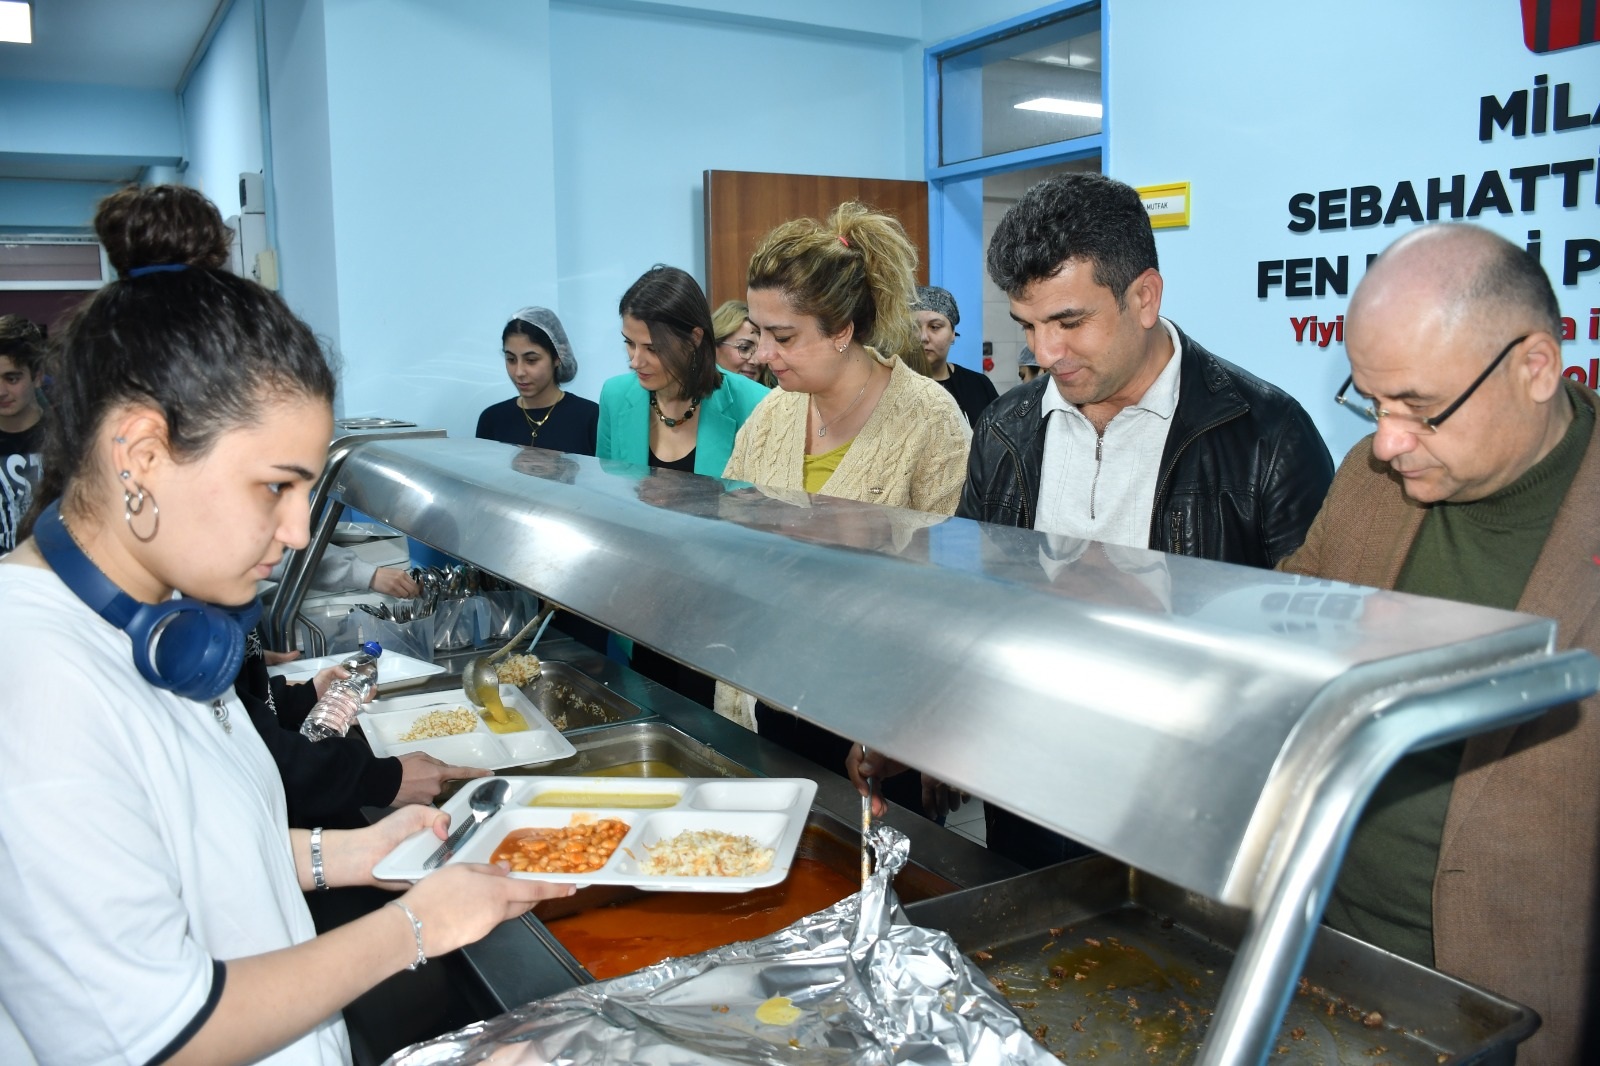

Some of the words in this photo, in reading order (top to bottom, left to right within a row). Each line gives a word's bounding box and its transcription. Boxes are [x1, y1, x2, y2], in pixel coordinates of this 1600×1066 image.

[1479, 74, 1600, 141] MİL
[1146, 202, 1169, 211] MUTFAK
[1257, 255, 1349, 298] FEN
[1289, 315, 1345, 348] Yiyi
